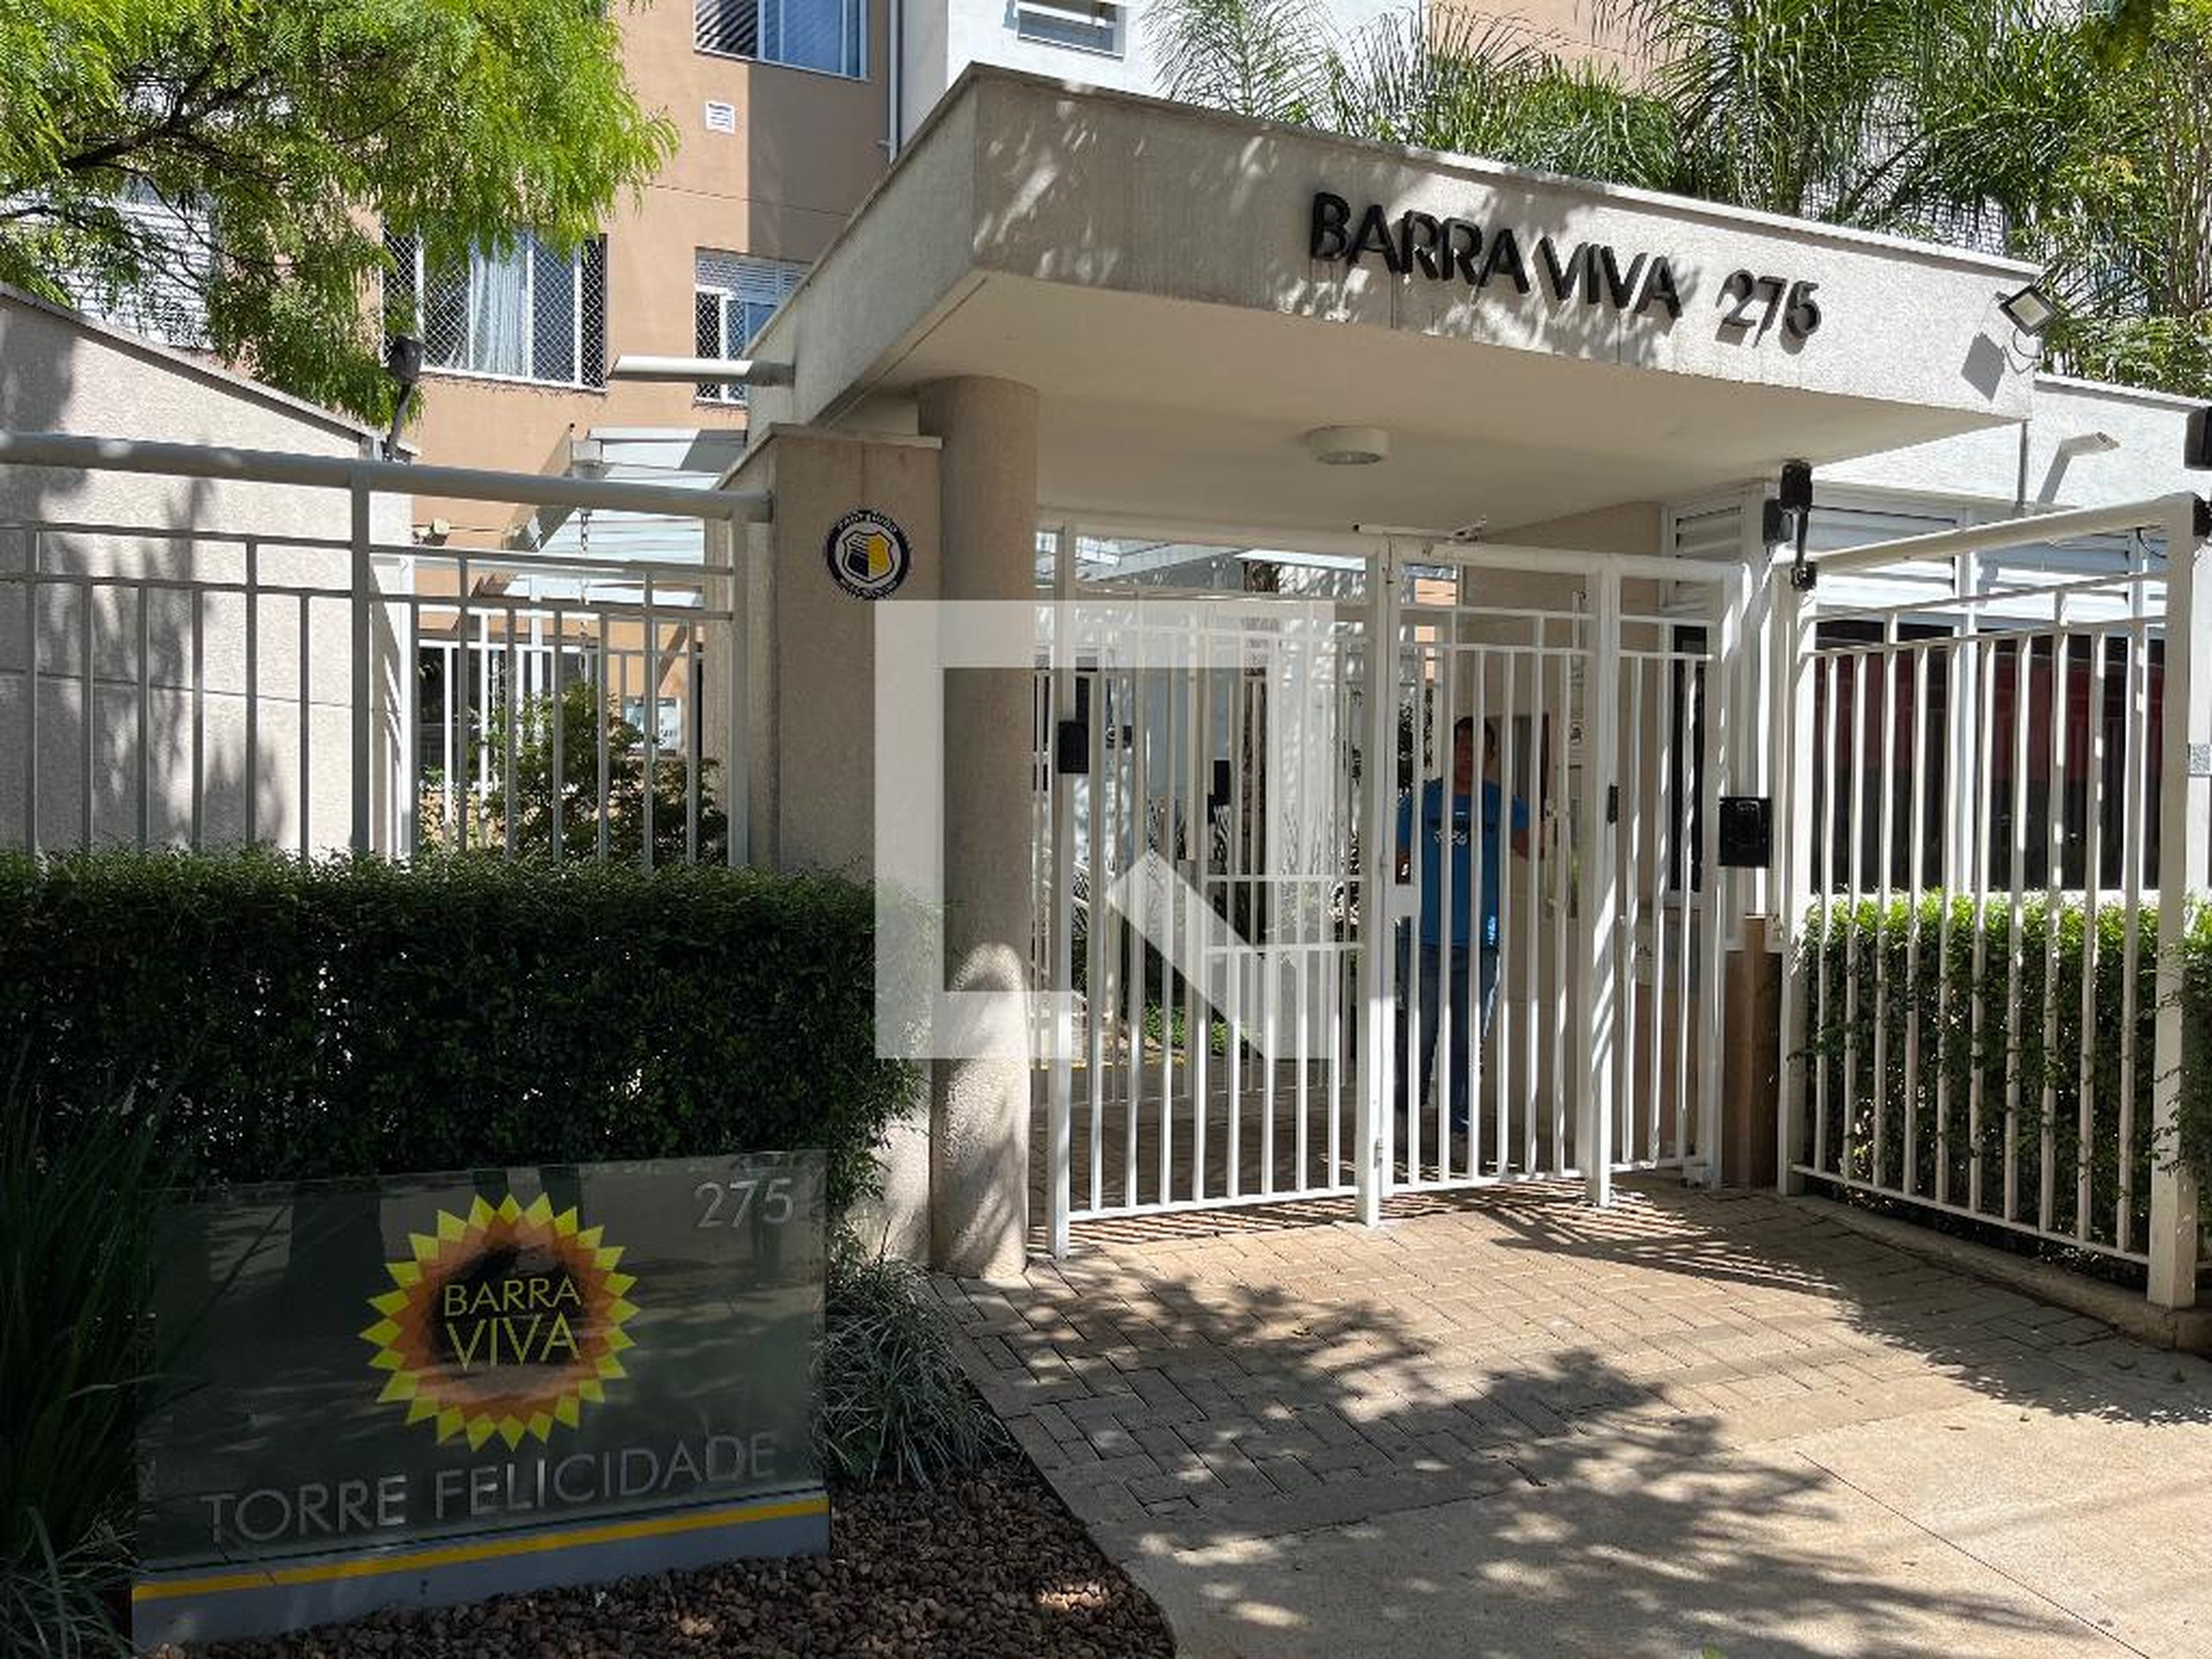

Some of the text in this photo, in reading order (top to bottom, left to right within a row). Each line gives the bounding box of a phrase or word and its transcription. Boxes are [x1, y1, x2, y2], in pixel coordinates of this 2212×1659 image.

[1311, 192, 1821, 341] BARRA VIVA 275
[696, 1178, 794, 1228] 275
[444, 1275, 582, 1317] BARRA
[446, 1312, 582, 1372] VIVA
[200, 1433, 776, 1543] TORRE FELICIDADE
